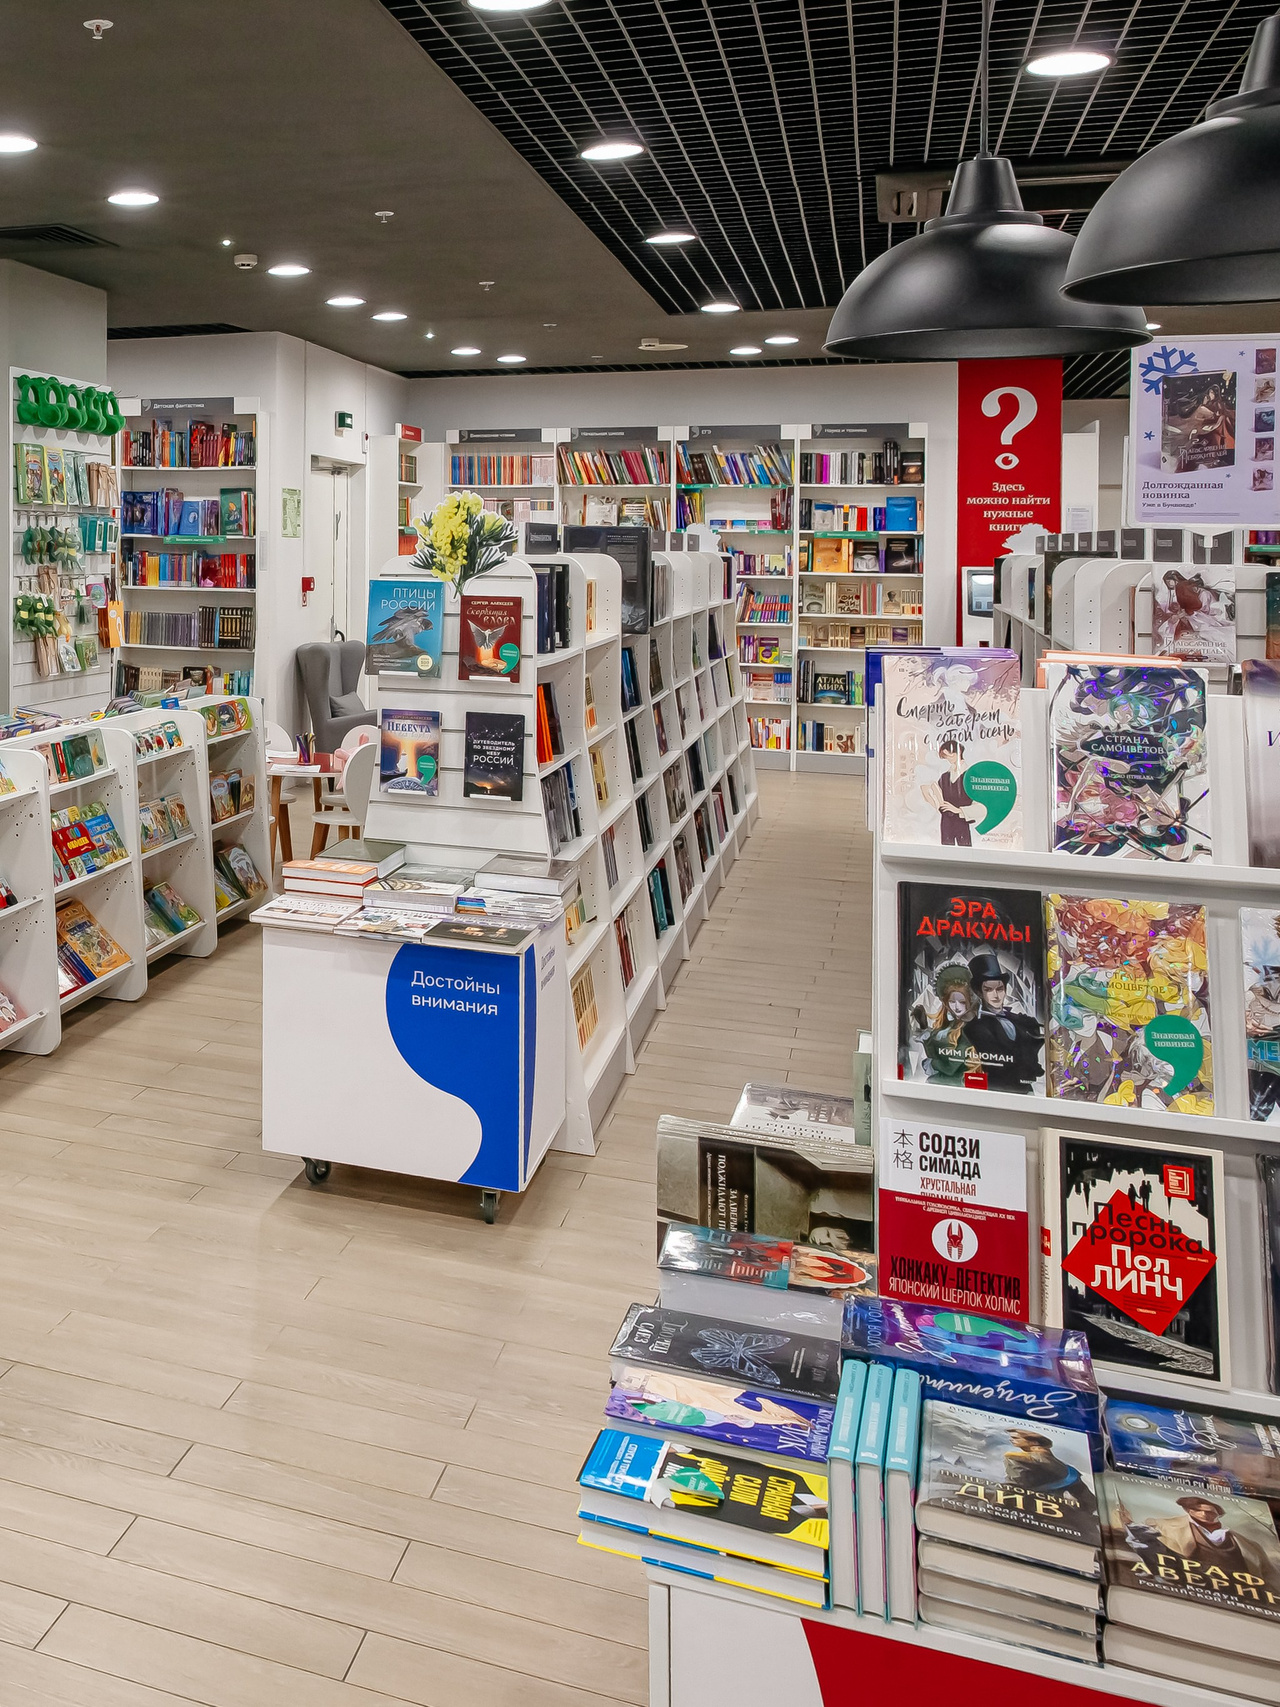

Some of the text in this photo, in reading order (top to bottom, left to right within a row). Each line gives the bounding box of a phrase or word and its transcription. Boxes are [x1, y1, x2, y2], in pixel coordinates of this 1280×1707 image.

[992, 482, 1025, 493] Здесь
[1142, 481, 1224, 492] Долгожданная
[1142, 490, 1190, 500] новинка
[966, 495, 1051, 505] можно найти
[983, 510, 1033, 520] нужные
[989, 523, 1022, 532] книг
[393, 587, 436, 600] ПТИЦЫ
[381, 599, 436, 611] РОССИИ
[816, 676, 846, 684] АТЛАС
[818, 683, 845, 691] МИРА
[896, 696, 956, 724] Смерть
[936, 707, 1001, 728] заберет
[387, 721, 431, 733] НЕВЕСТА
[936, 726, 975, 742] собой
[979, 725, 1016, 740] осень
[473, 739, 516, 747] ПУТЕВОДИТЕЛЬ
[1091, 742, 1165, 755] САМОЦВЕТОВ
[1104, 735, 1150, 745] СТРАНА
[473, 755, 514, 765] РОССИИ
[970, 774, 1010, 785] Знаковая
[971, 783, 1009, 792] новинка
[950, 897, 997, 919] ЭРА
[916, 916, 1032, 943] ДРАКУЛЫ
[411, 970, 500, 995] Достойны
[411, 994, 498, 1016] внимания
[1150, 1030, 1196, 1042] Знаковая
[1152, 1040, 1196, 1049] новинка
[938, 1047, 1014, 1064] КИМ НЬЮМАН
[893, 1128, 914, 1170] 本格
[918, 1131, 981, 1160] СОДЗИ
[919, 1155, 981, 1180] СИМАДА
[716, 1154, 726, 1218] ПОДЖИДАЮТ
[729, 1188, 738, 1199] ЗА
[920, 1176, 977, 1197] ХРУСТАЛЬНАЯ
[1093, 1202, 1183, 1235] Песнь
[1072, 1221, 1204, 1255] пророка
[1110, 1244, 1170, 1273] Пол
[890, 1255, 1021, 1299] ХОНКАКУ-ДЕТЕКТИВ
[1091, 1264, 1184, 1302] ЛИНЧ
[888, 1278, 1021, 1315] ЯПОНСКИЙ ШЕРЛОК ХОЛМС
[633, 1322, 656, 1344] СЛЕЗ
[648, 1320, 689, 1355] ТВОРЕЦ
[949, 1405, 1067, 1436] Виктор Дашкевич
[728, 1474, 762, 1506] САЛЛИ
[760, 1475, 797, 1521] СТРАННАЯ
[940, 1469, 1081, 1508] ИМПЕРАТОРСКИЙ
[1122, 1475, 1249, 1505] Виктор Дашкевич
[955, 1483, 1065, 1519] ДИВ
[986, 1501, 1034, 1520] Колдун
[941, 1497, 1082, 1537] Российской империи
[1156, 1553, 1266, 1587] ГРАФ
[1138, 1579, 1222, 1603] Российской
[1186, 1584, 1239, 1602] Колдун
